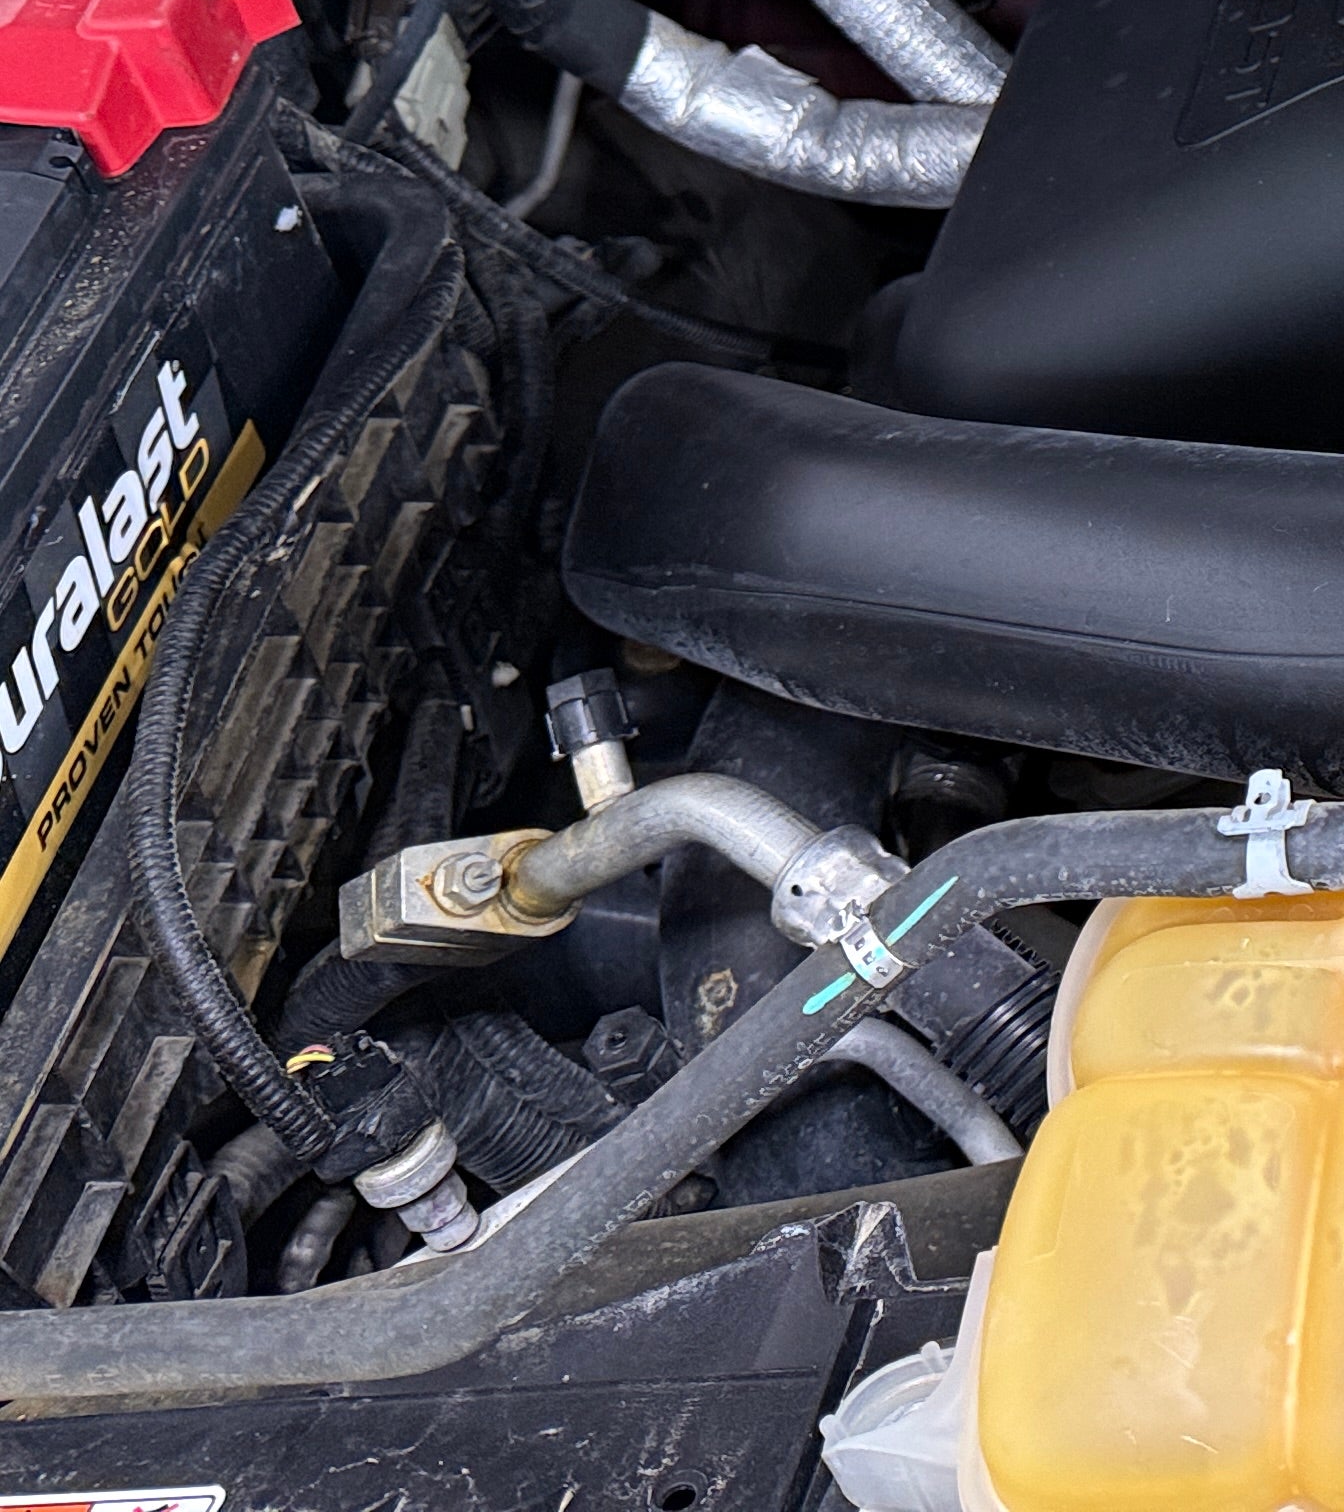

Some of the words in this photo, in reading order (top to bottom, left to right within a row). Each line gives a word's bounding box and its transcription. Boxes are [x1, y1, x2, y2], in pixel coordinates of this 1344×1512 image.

[0, 360, 200, 778] uralast
[106, 437, 209, 633] GOLD
[36, 667, 132, 853] PROVEN
